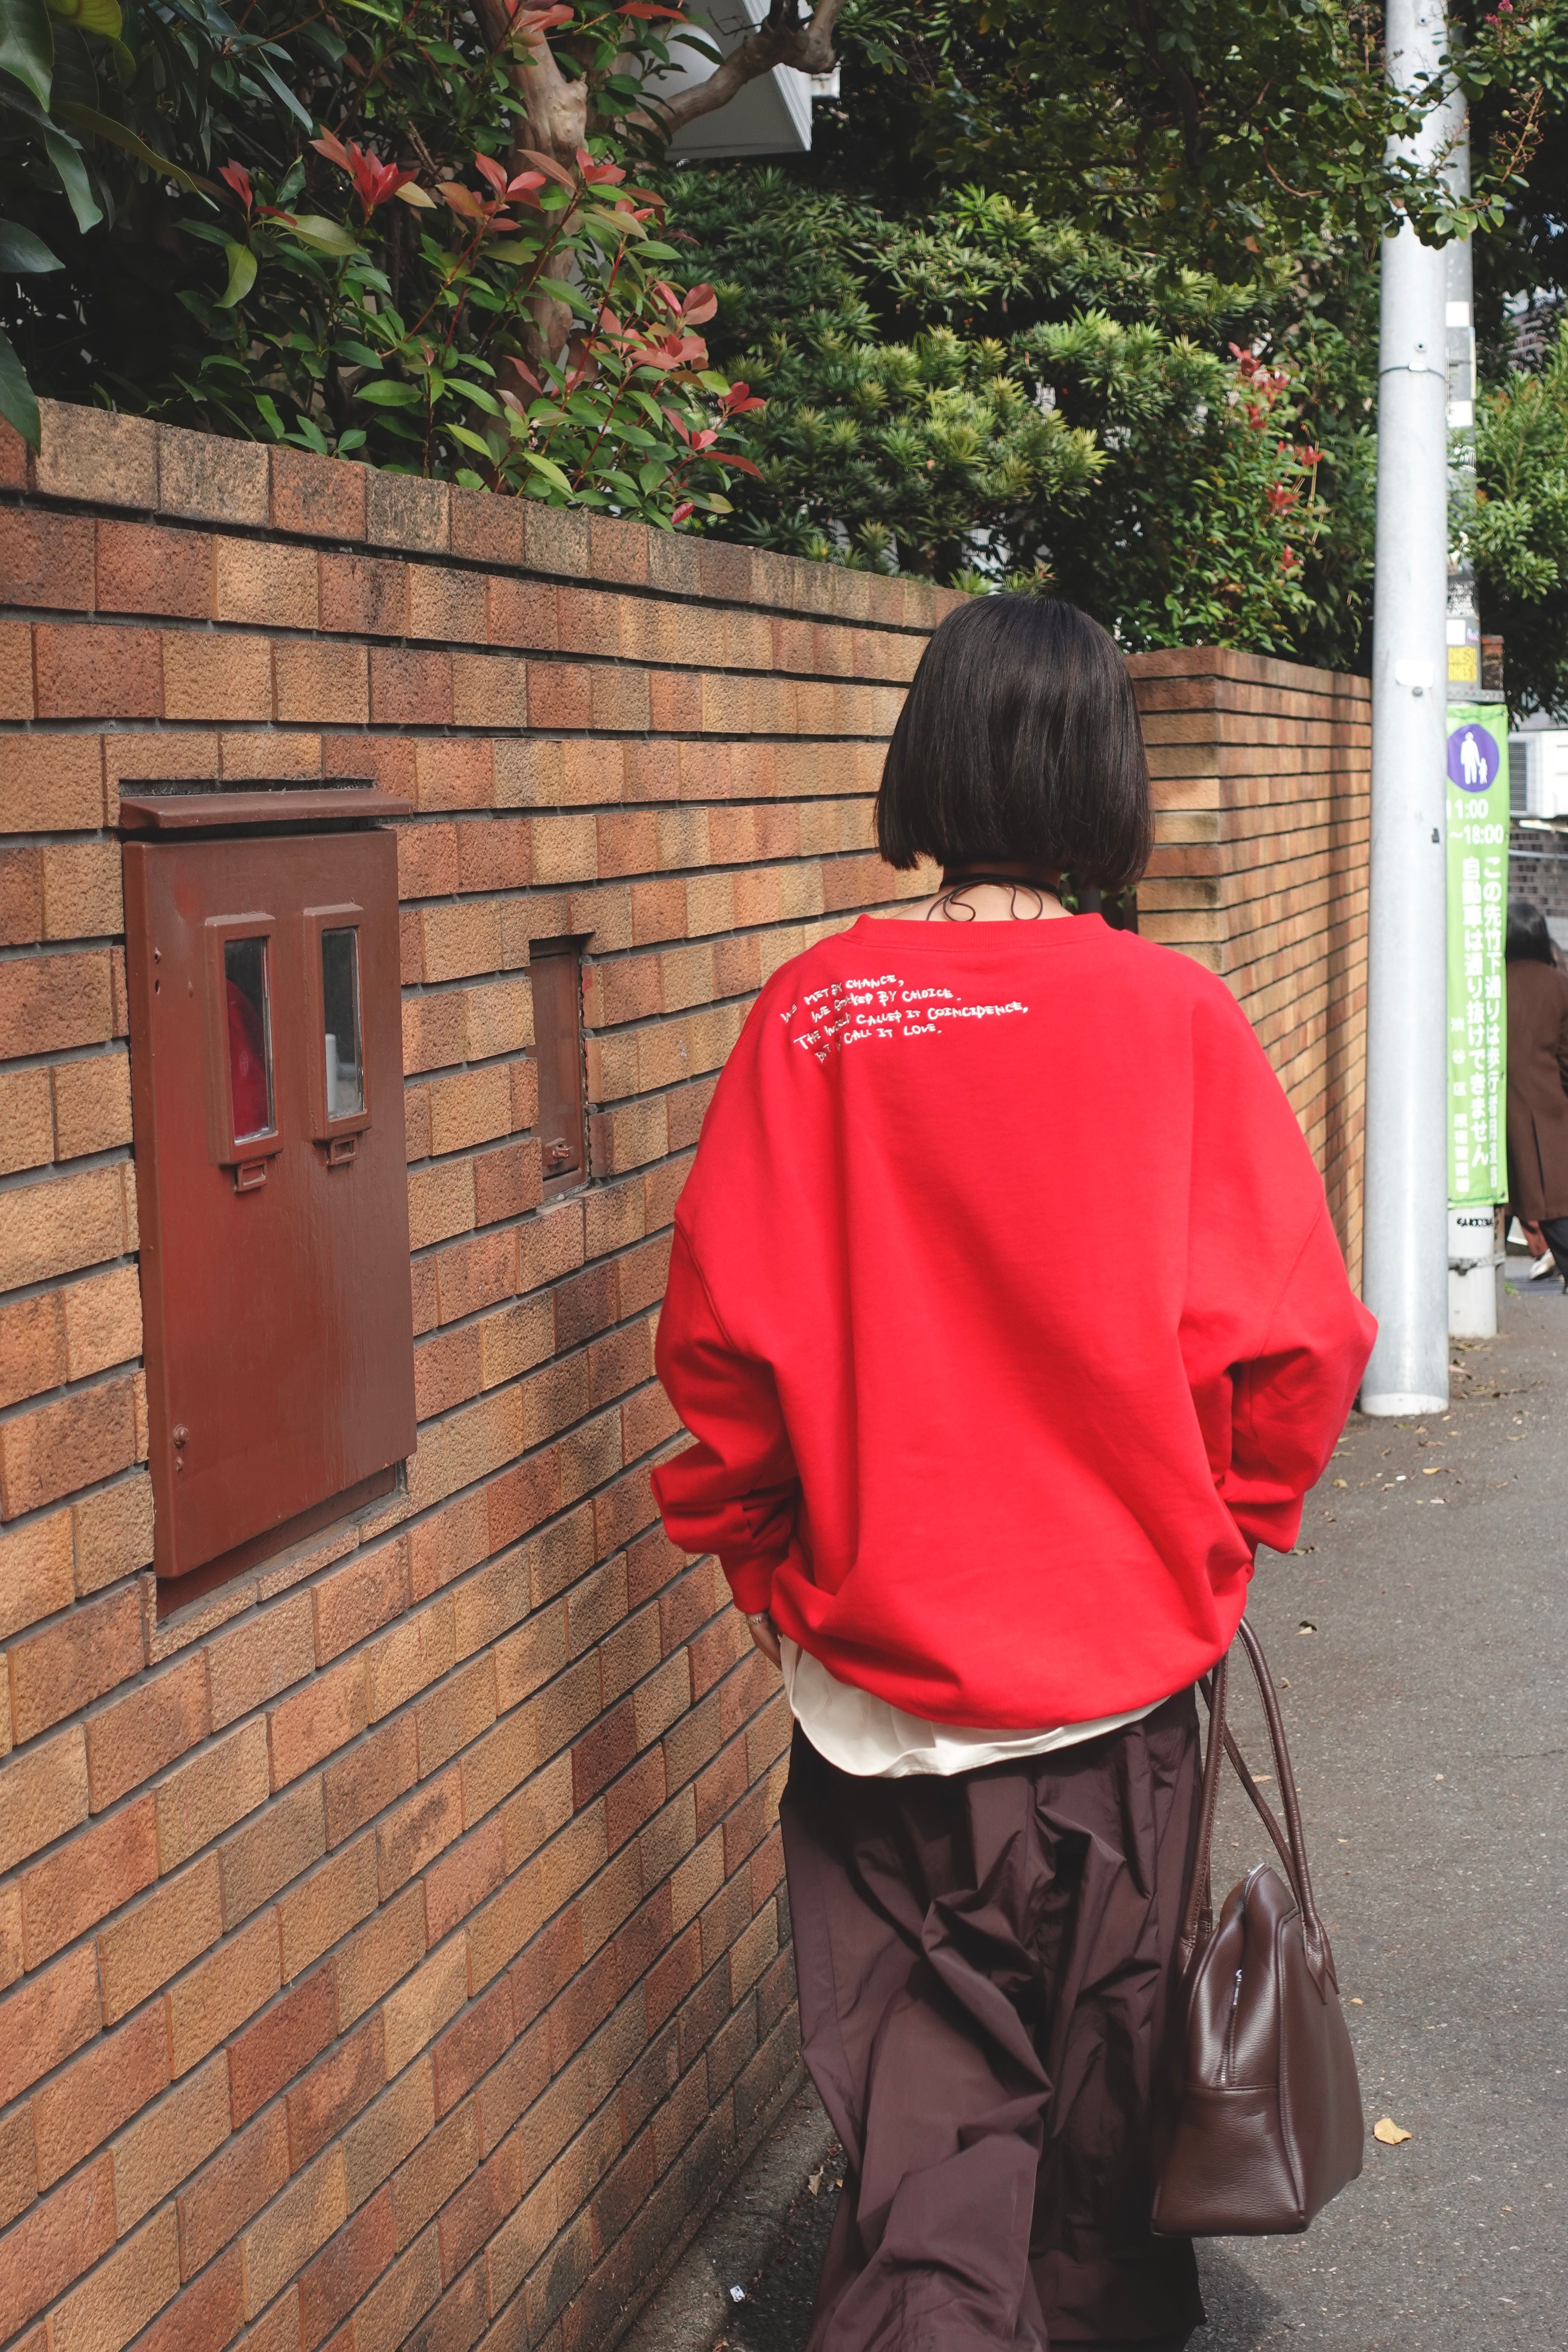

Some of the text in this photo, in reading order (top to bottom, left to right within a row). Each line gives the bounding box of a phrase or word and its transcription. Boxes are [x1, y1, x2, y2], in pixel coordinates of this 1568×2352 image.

[780, 1004, 797, 1024] WE
[804, 988, 829, 1005] MET
[845, 974, 904, 989] CHANCE,
[811, 1005, 831, 1023] WE
[876, 990, 897, 1007] BY
[1461, 855, 1489, 1167] 自動車は通り抜けできません
[793, 1030, 821, 1050] THE
[856, 1010, 902, 1026] CALLED
[906, 1010, 921, 1019] IT
[928, 1001, 1029, 1020] COINCIDENCE,
[844, 1029, 873, 1044] CALL
[876, 1028, 893, 1038] IT
[903, 1023, 942, 1036] LOVE.
